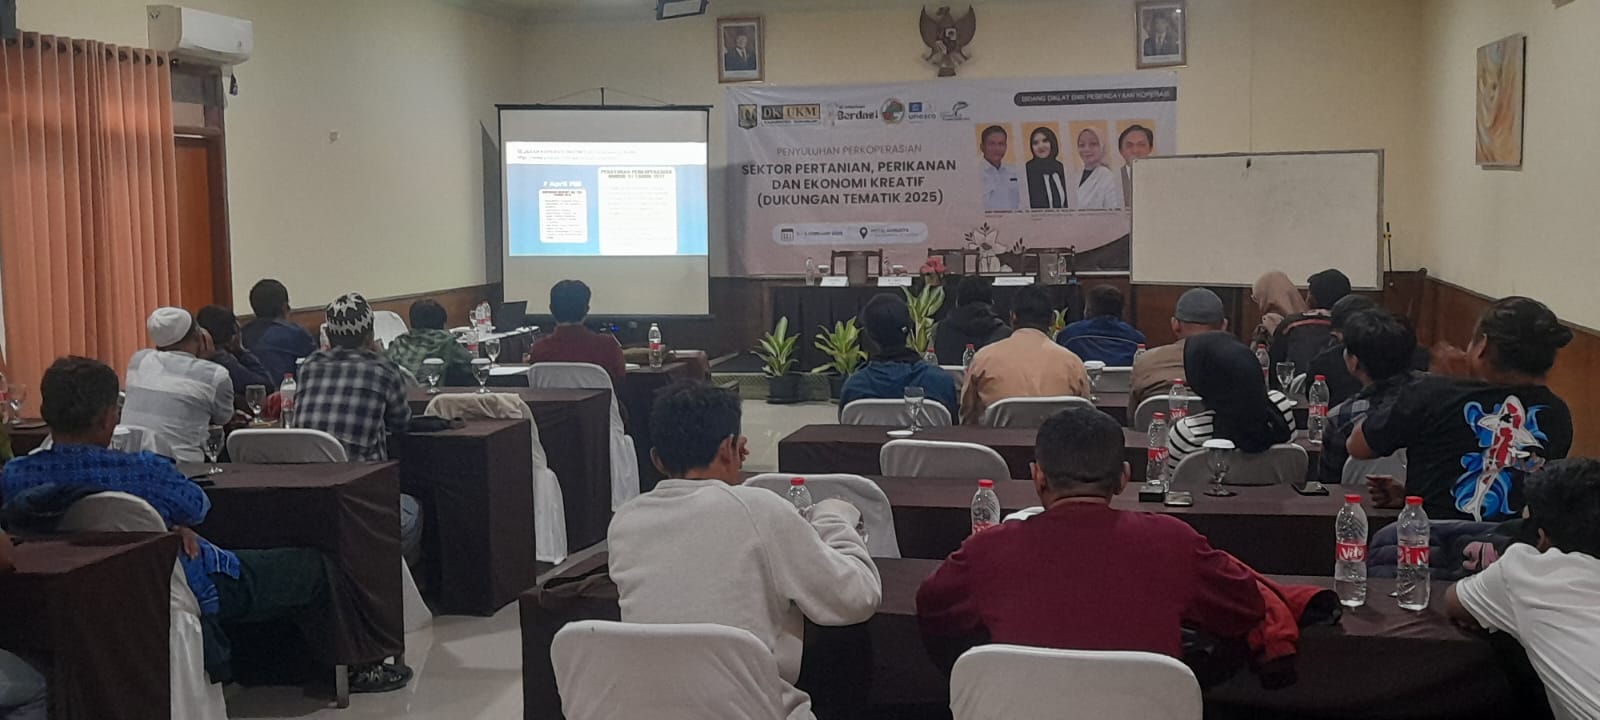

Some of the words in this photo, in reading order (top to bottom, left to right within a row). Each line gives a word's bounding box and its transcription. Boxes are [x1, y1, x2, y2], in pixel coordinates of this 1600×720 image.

[786, 102, 817, 118] UKM
[776, 146, 840, 157] PENYULUHAN
[842, 143, 922, 155] PERKOPERASIAN
[741, 164, 792, 176] SEKTOR
[795, 162, 875, 175] PERTANIAN,
[877, 159, 957, 173] PERIKANAN
[771, 179, 801, 190] DAN
[803, 177, 868, 190] EKONOMI
[870, 176, 926, 189] KREATIF
[757, 192, 840, 208] (DUKUNGAN
[842, 191, 901, 205] TEMATIK
[904, 189, 944, 205] 2025)
